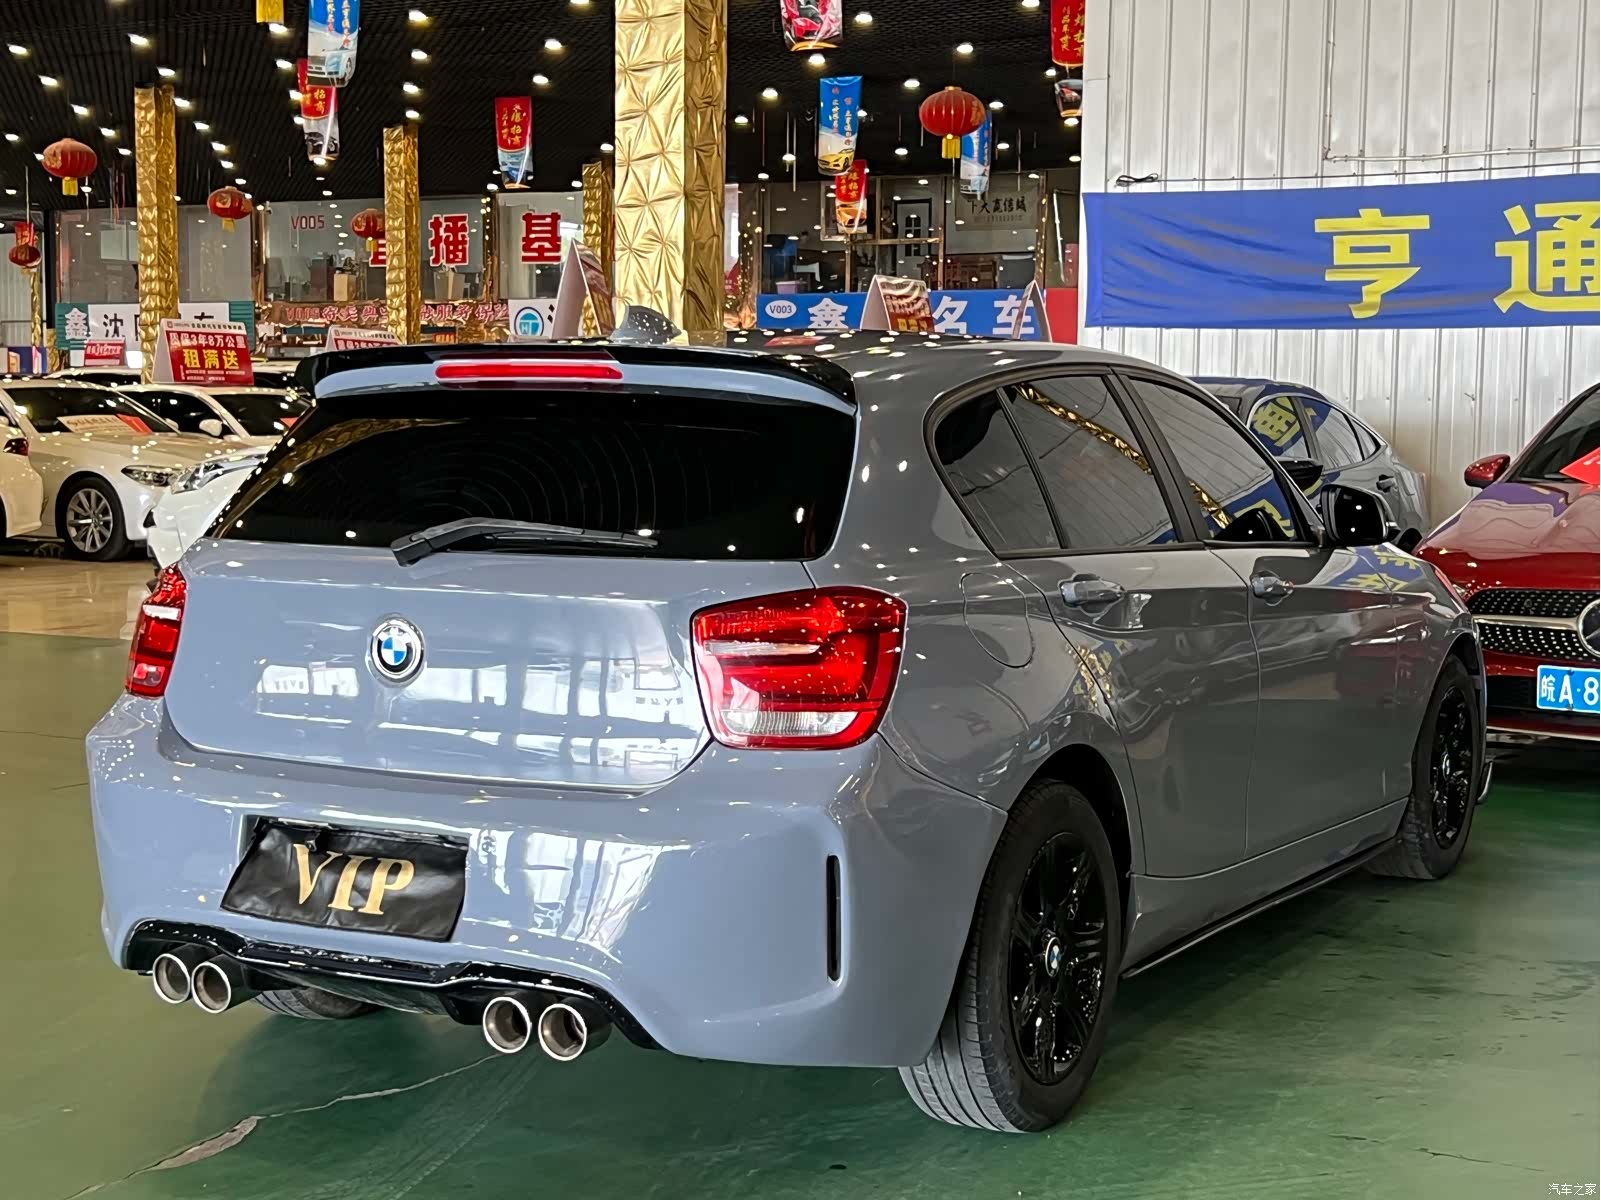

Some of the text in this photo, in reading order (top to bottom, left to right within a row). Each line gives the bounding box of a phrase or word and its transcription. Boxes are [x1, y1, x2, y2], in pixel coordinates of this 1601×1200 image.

[291, 214, 325, 230] V005
[769, 303, 793, 314] V003
[183, 348, 240, 370] 租满送
[292, 842, 415, 916] VIP
